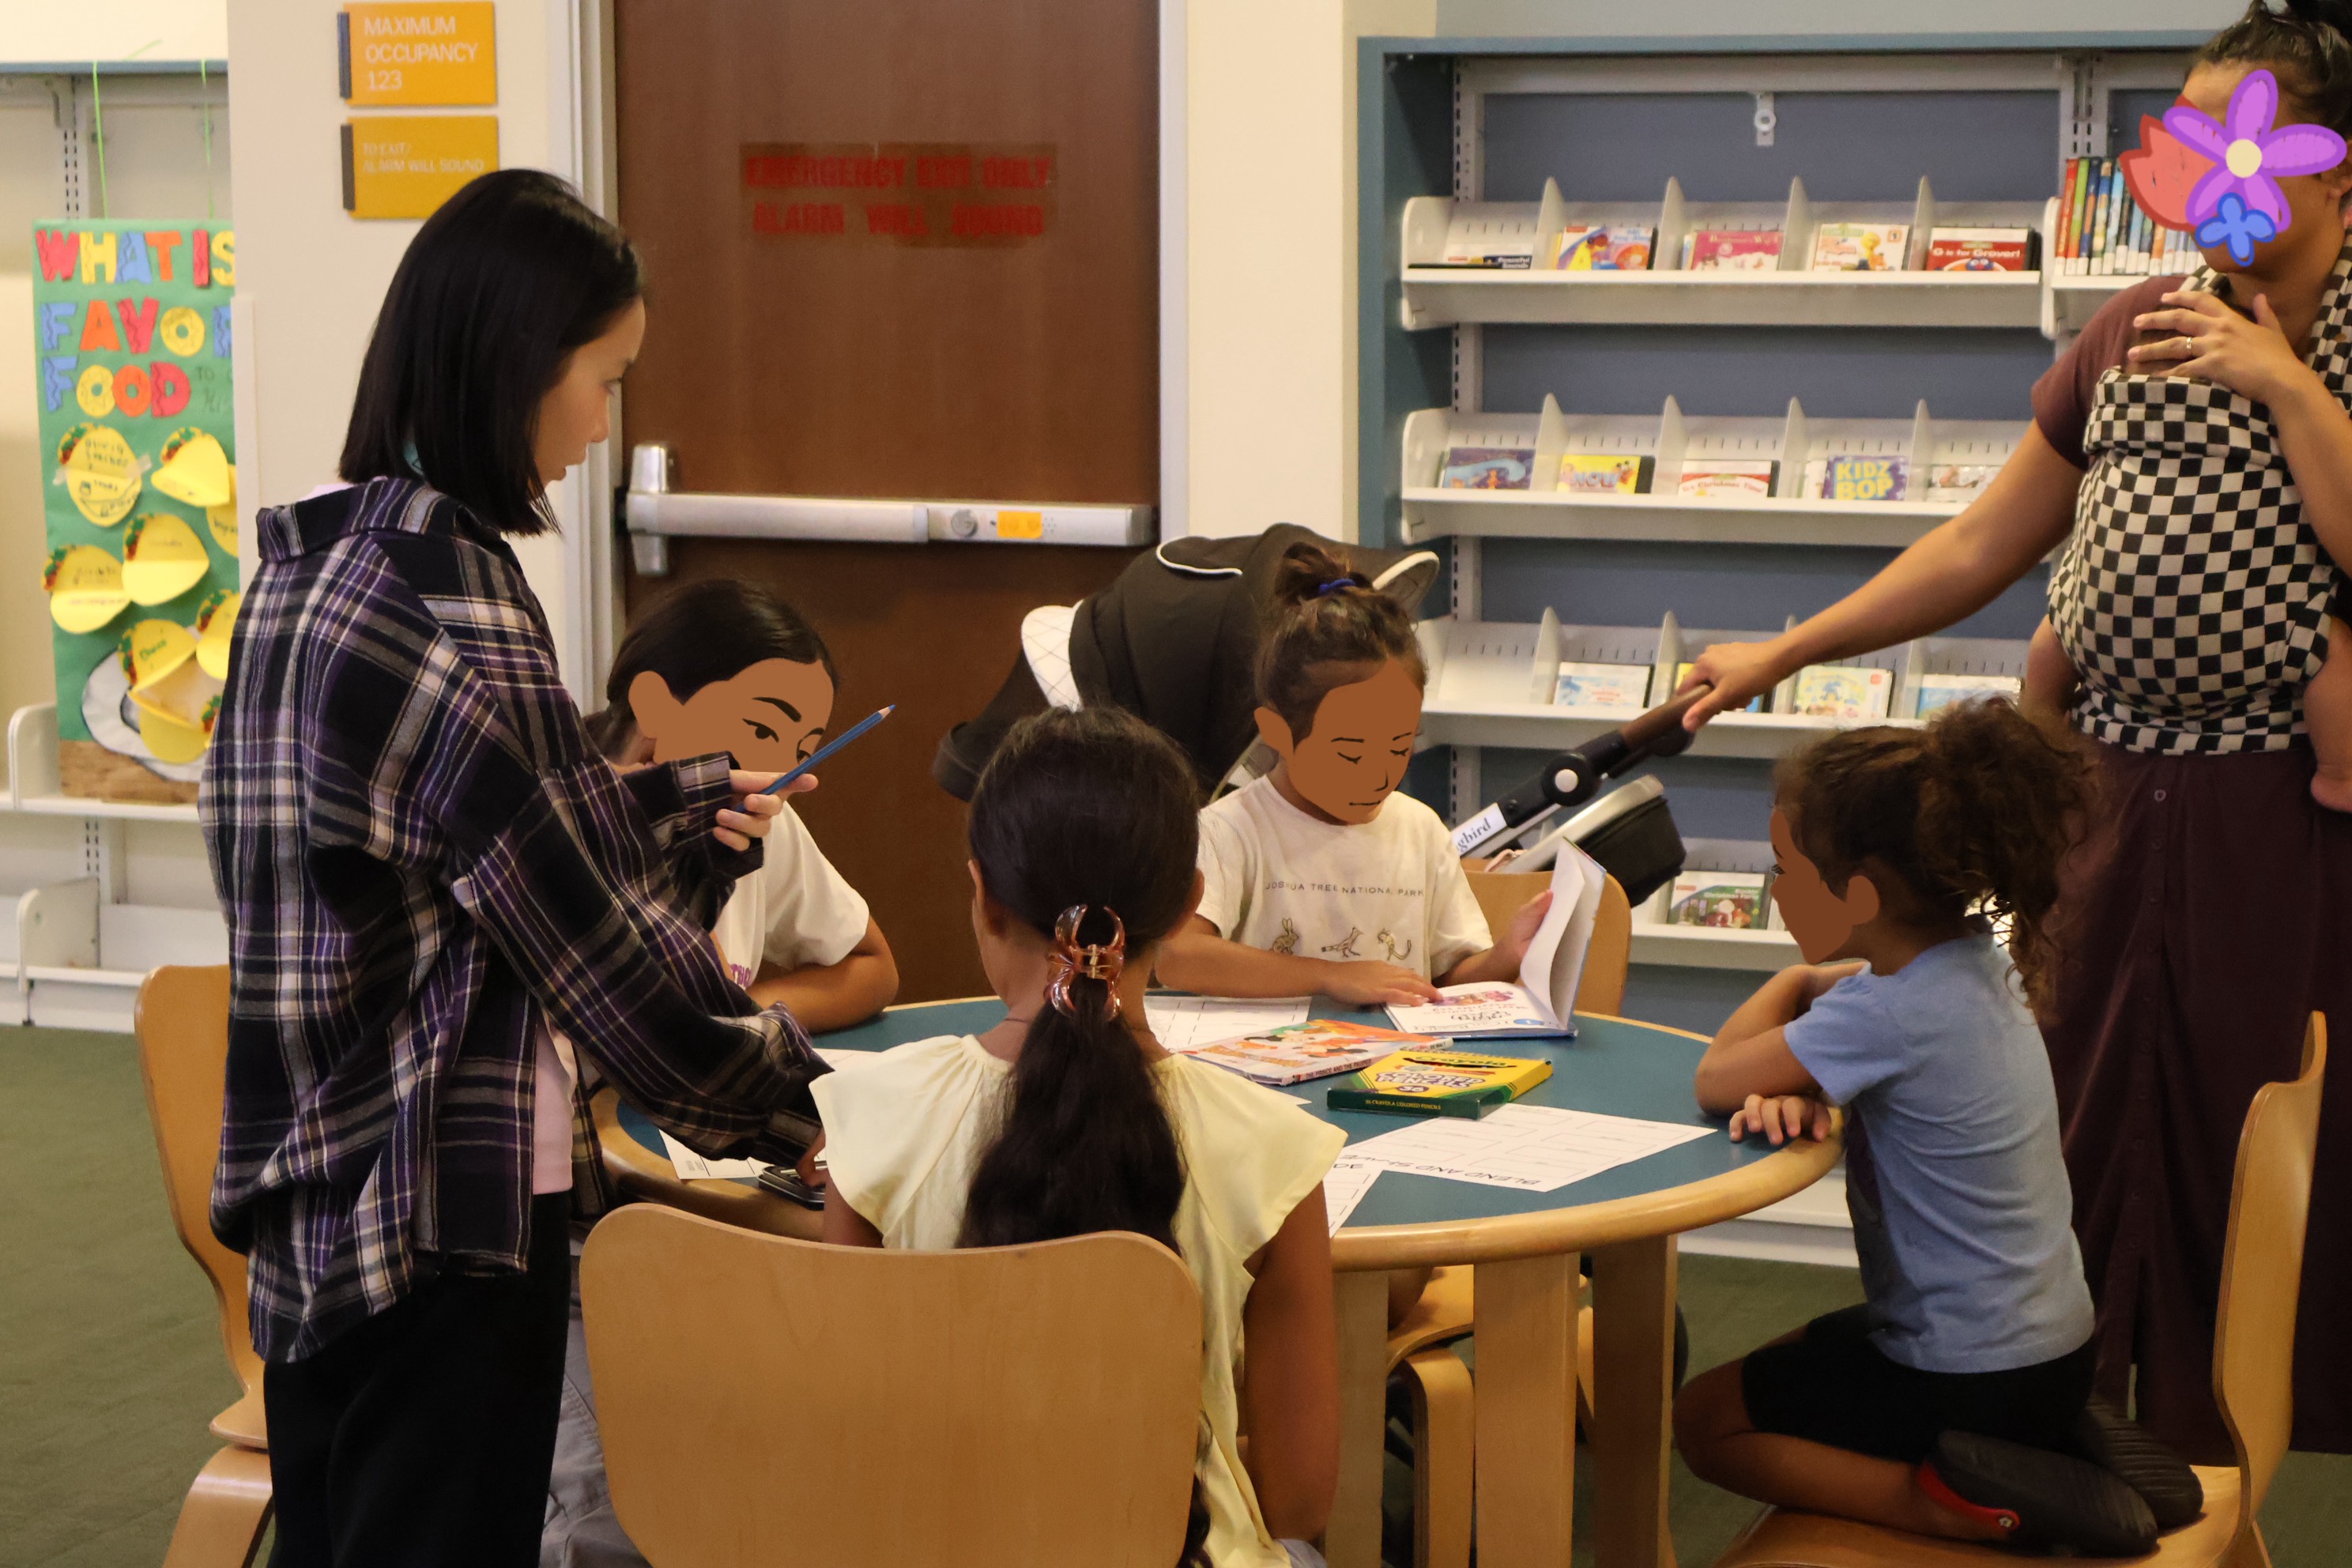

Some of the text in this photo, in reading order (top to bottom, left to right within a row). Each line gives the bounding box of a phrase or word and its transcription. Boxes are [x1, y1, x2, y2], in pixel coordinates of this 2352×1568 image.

[364, 16, 456, 36] MAXIMUM
[365, 42, 479, 64] OCCUPANCY
[368, 70, 402, 92] 123
[408, 160, 435, 172] WILL
[439, 159, 484, 172] SOUND
[747, 153, 906, 188] EMERGENCY
[982, 153, 1052, 189] ONLY
[752, 201, 1045, 237] ALARM WILL SOUND
[36, 228, 235, 287] WHAT IS
[1932, 247, 1944, 257] G
[1972, 248, 2021, 258] Grover!
[43, 356, 191, 418] FOOD
[1836, 461, 1891, 481] KIDZ
[1836, 477, 1894, 500] BOP
[1311, 883, 1338, 892] TREE
[1342, 886, 1393, 895] NATIONA
[1397, 888, 1424, 897] PARK
[1353, 1058, 1372, 1069] PAUPER
[1415, 1056, 1507, 1067] Crayola
[1375, 1076, 1472, 1089] PENCILS
[1377, 1072, 1486, 1084] COLORED
[1415, 1166, 1463, 1174] AND
[1464, 1172, 1542, 1185] BLEND
